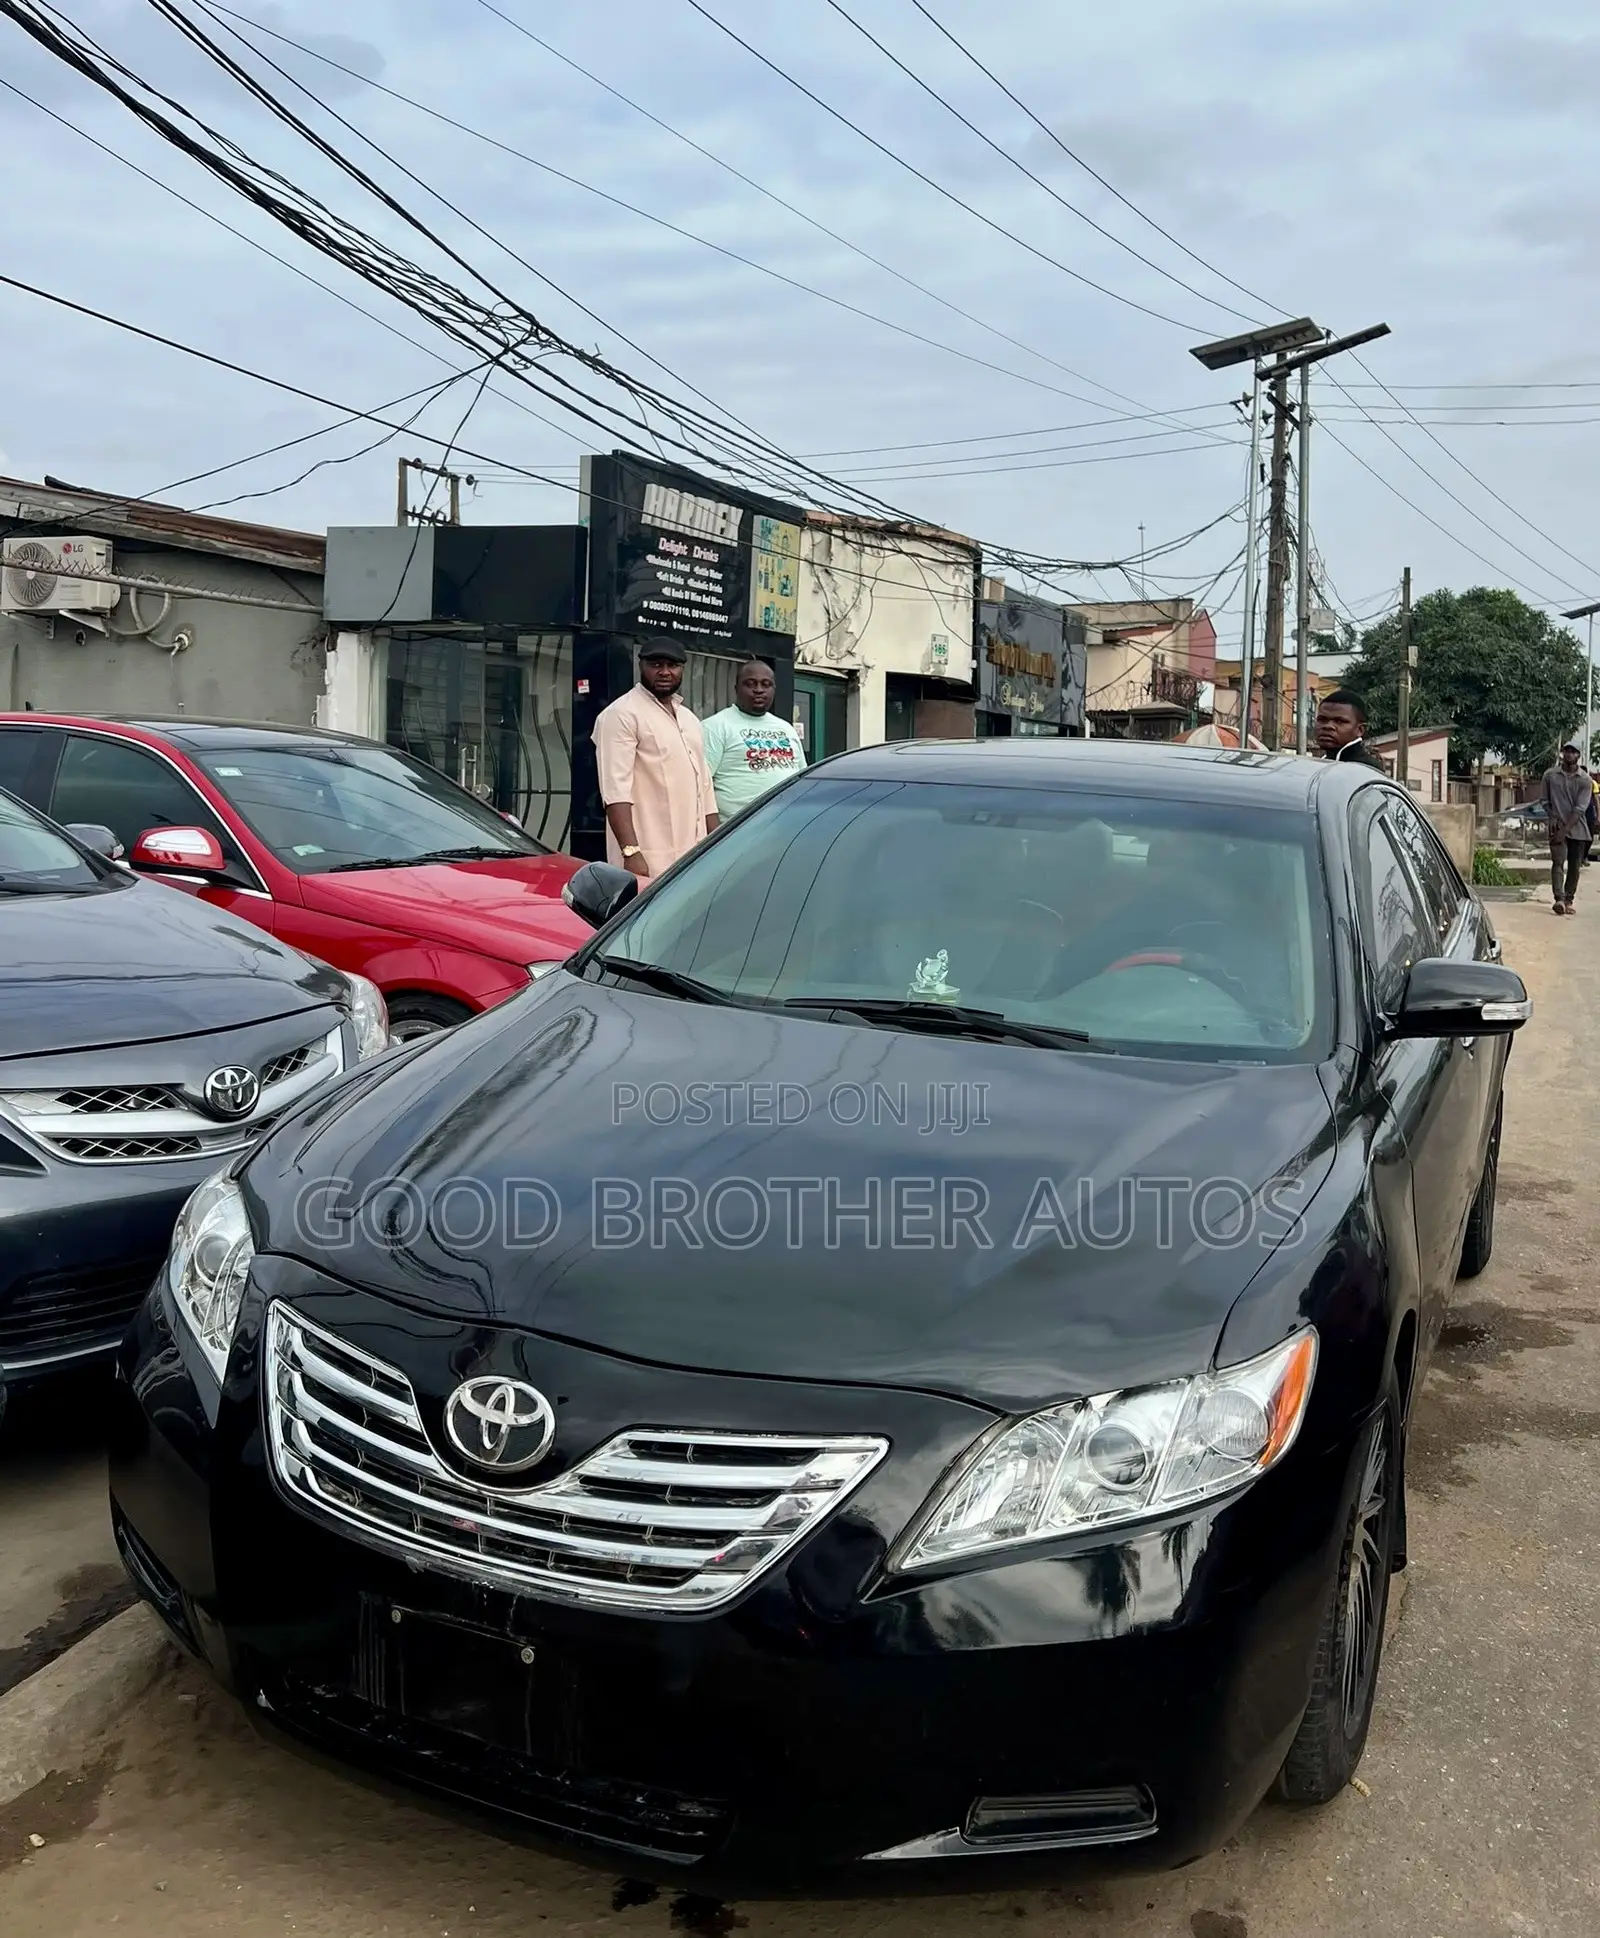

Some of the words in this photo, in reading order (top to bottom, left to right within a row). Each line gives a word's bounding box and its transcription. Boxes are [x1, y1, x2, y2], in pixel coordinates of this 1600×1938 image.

[73, 544, 84, 553] LG
[658, 537, 688, 556] Delight
[693, 545, 719, 563] Drinks
